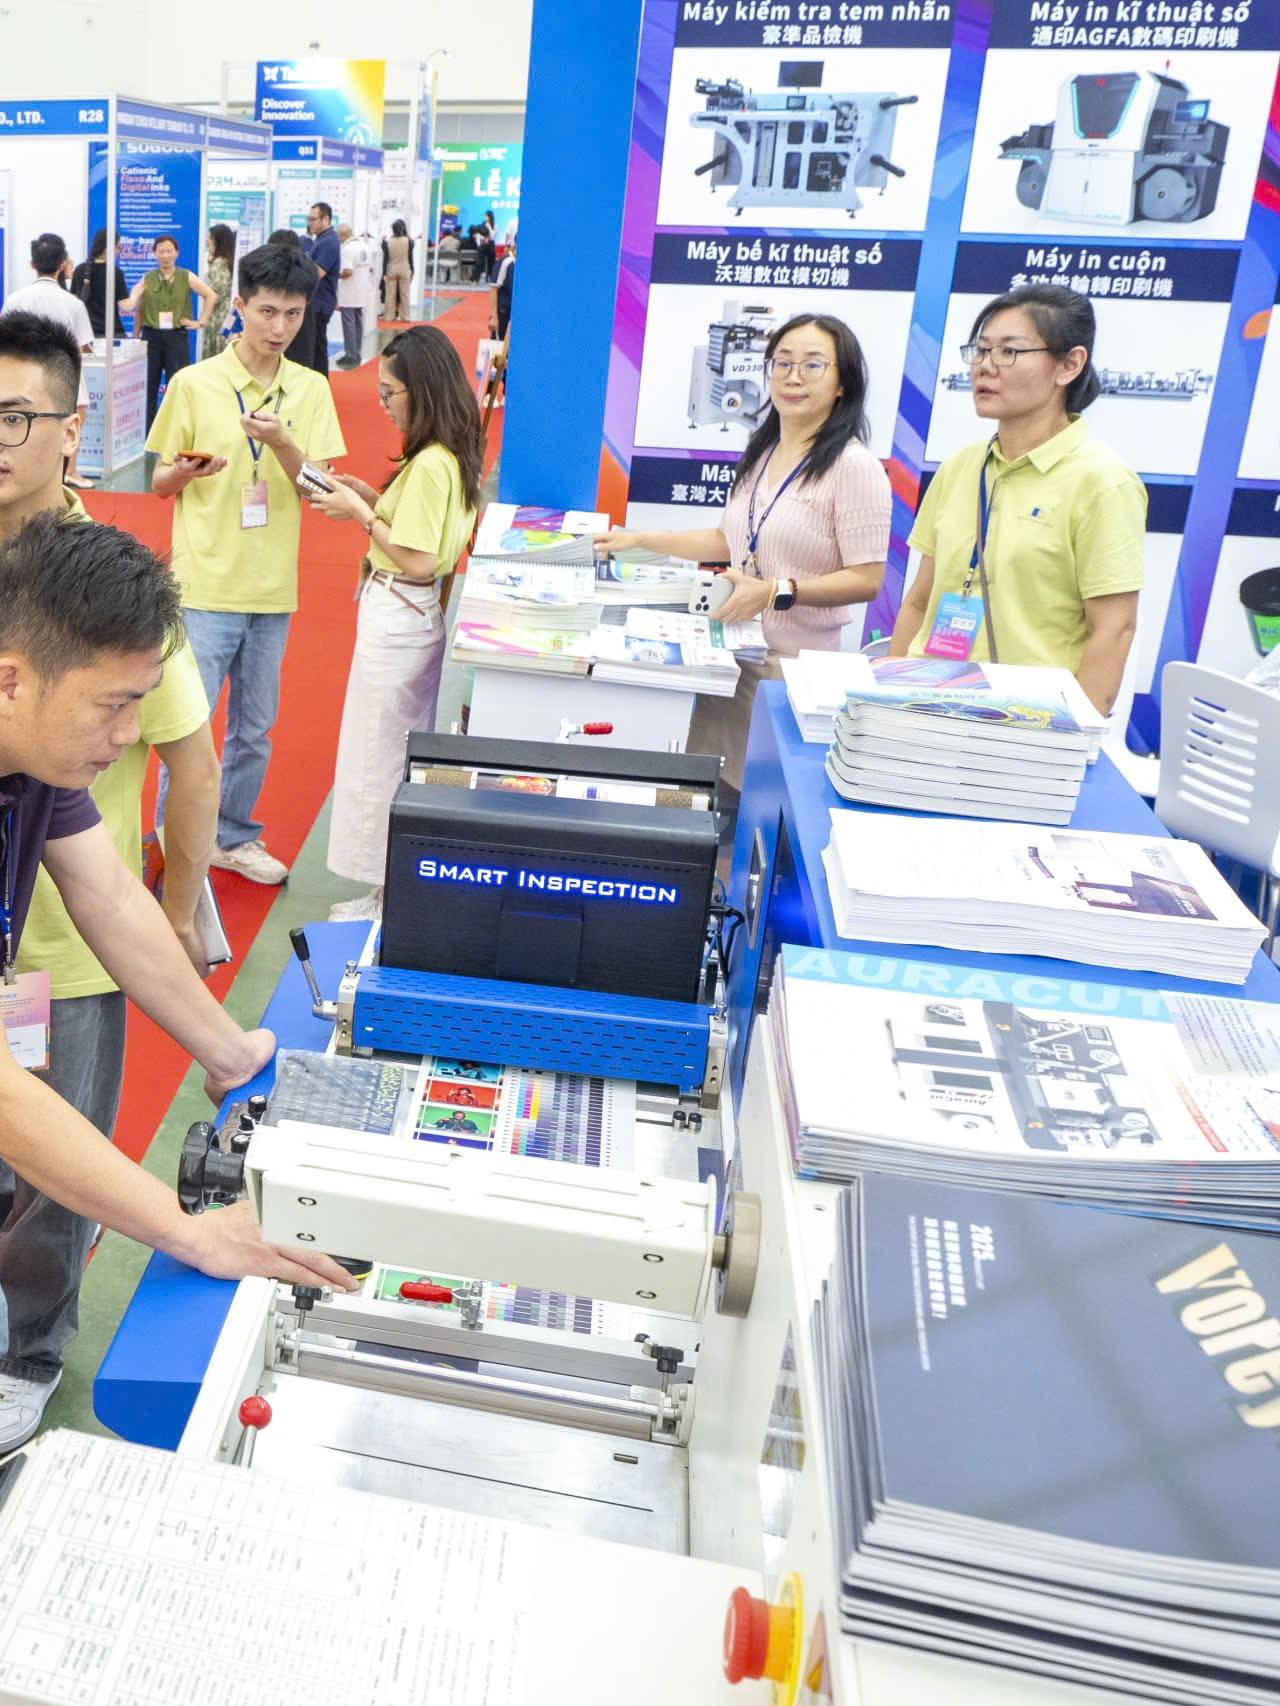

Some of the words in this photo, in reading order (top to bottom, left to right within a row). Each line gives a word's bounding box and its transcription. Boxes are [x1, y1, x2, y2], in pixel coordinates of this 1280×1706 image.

[683, 1, 728, 25] Máy
[798, 3, 831, 21] tra
[839, 4, 883, 21] tem
[1030, 0, 1079, 26] Máy
[1085, 1, 1109, 22] in
[1116, 1, 1143, 22] kĩ
[1146, 1, 1215, 27] thuật
[1220, 0, 1252, 23] số
[261, 98, 306, 110] Discover
[16, 111, 45, 124] LTD.
[78, 109, 105, 123] R28
[261, 110, 315, 121] Innovation
[120, 167, 158, 175] Cationic
[146, 175, 164, 183] And
[120, 183, 150, 192] Digital
[150, 183, 170, 192] Inks
[687, 241, 731, 264] Máy
[736, 238, 763, 261] bế
[768, 243, 790, 262] kĩ
[793, 243, 850, 268] thuật
[854, 242, 883, 265] số
[1025, 246, 1073, 273] Máy
[1078, 249, 1101, 270] in
[1108, 250, 1167, 276] cuộn
[715, 263, 850, 287] 沃瑞數位模切機
[671, 483, 732, 503] 臺灣大
[788, 951, 1172, 1018] AURACUT
